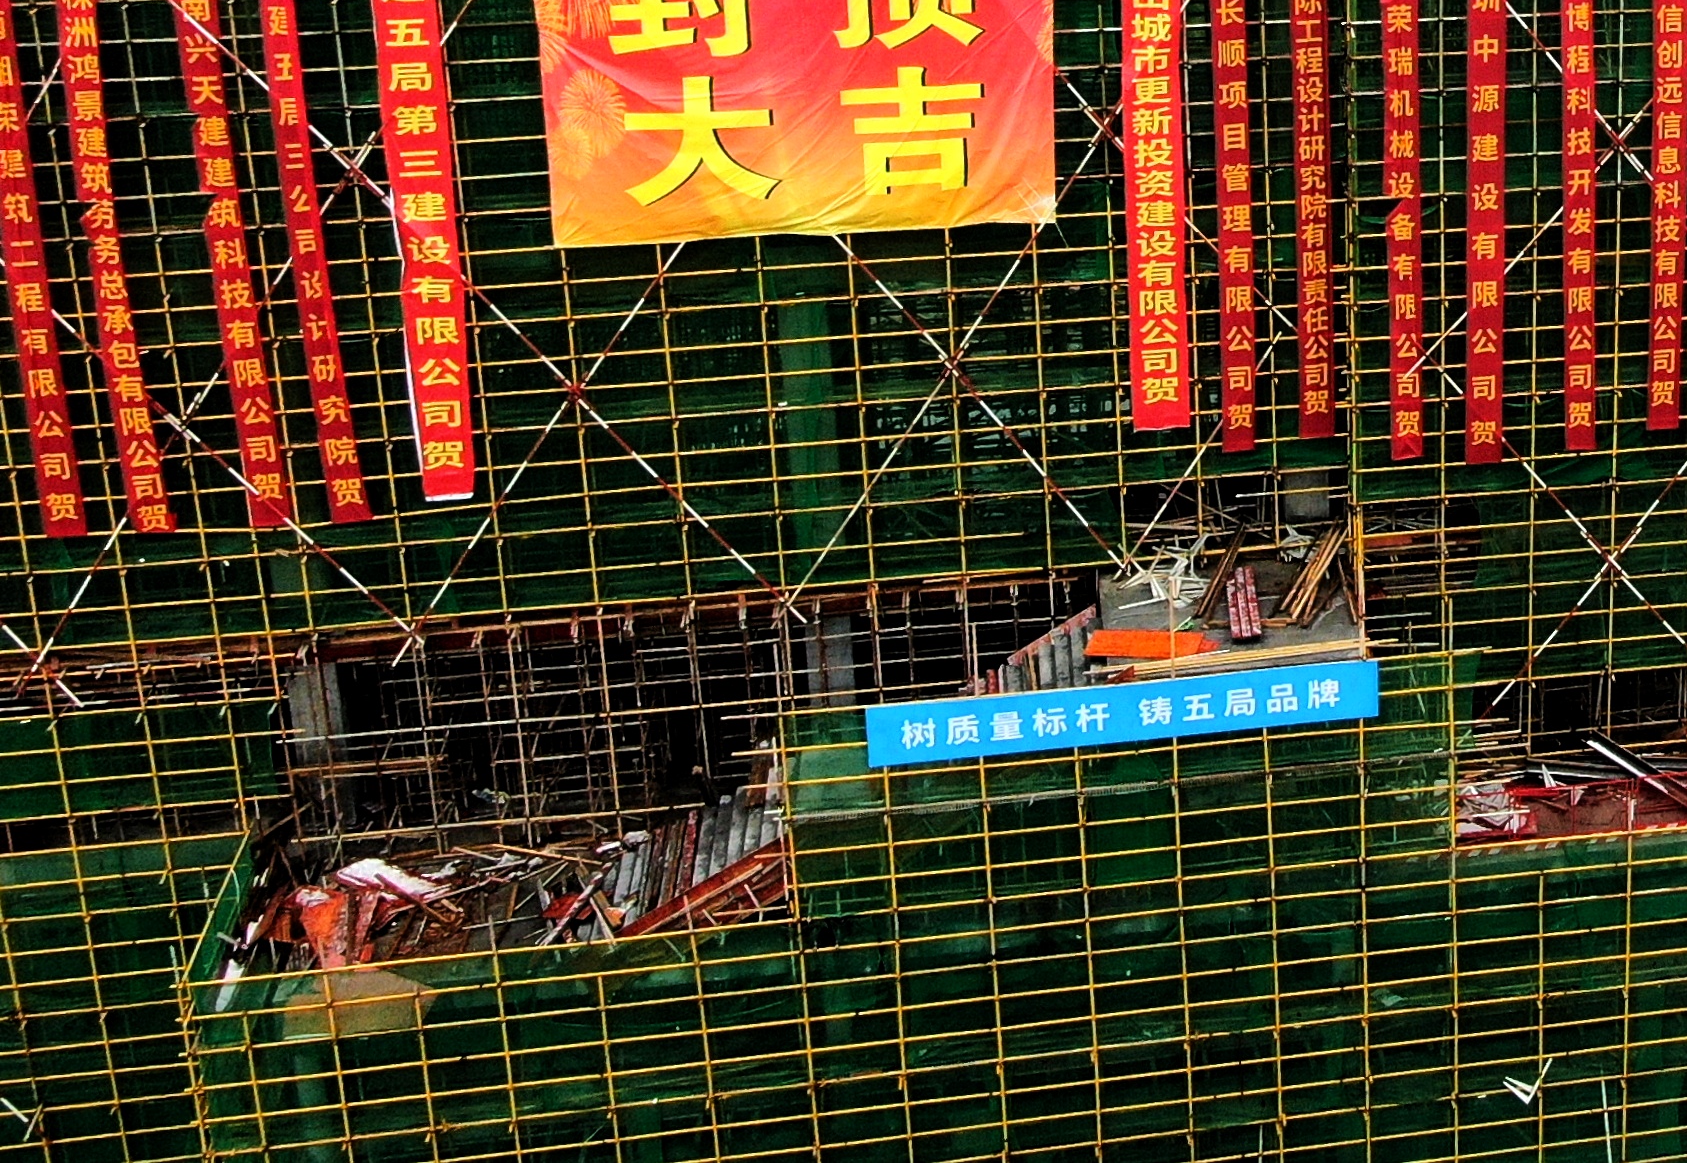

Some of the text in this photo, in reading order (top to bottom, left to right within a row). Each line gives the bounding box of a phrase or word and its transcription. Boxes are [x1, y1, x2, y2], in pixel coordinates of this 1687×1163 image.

[624, 66, 984, 207] 大吉
[901, 679, 1342, 750] 树质量标杆 铸五局品牌
